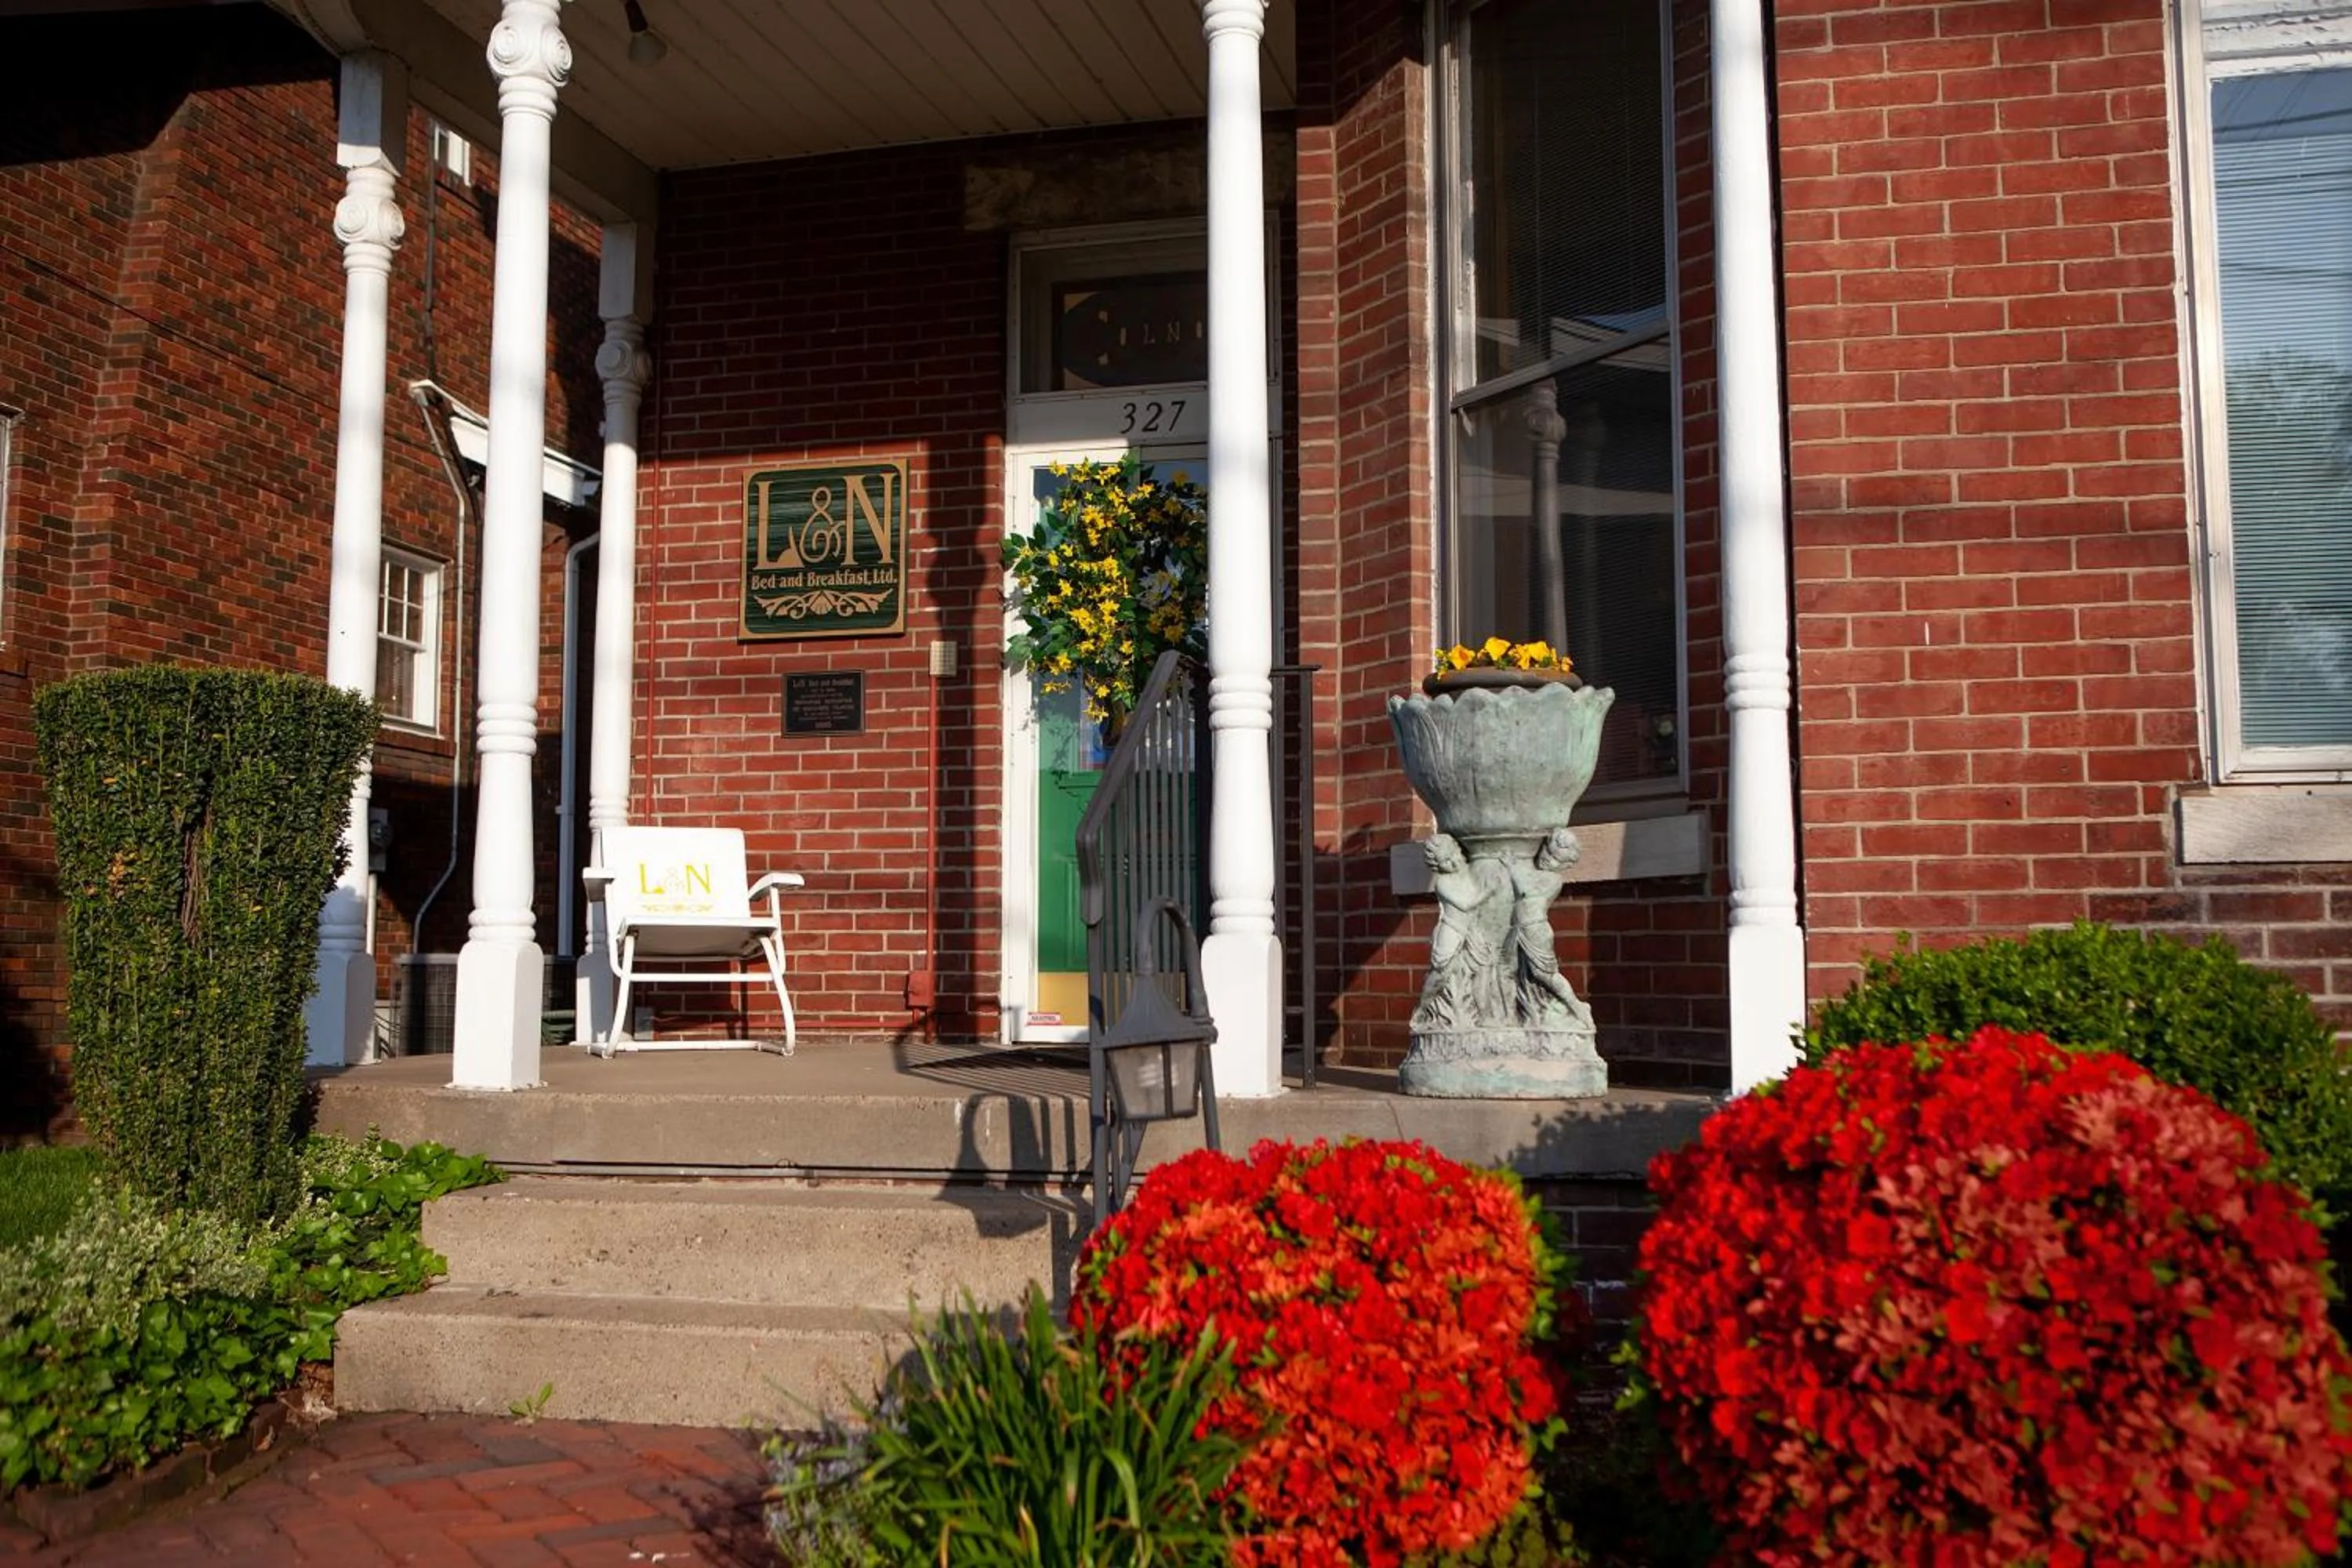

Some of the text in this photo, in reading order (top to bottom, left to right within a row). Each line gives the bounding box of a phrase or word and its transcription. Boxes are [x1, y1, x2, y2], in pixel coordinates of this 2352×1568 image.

[1120, 401, 1186, 434] 327
[753, 473, 898, 570] L&N
[751, 574, 775, 590] Bed
[779, 572, 803, 587] and
[873, 568, 898, 584] Ltd.
